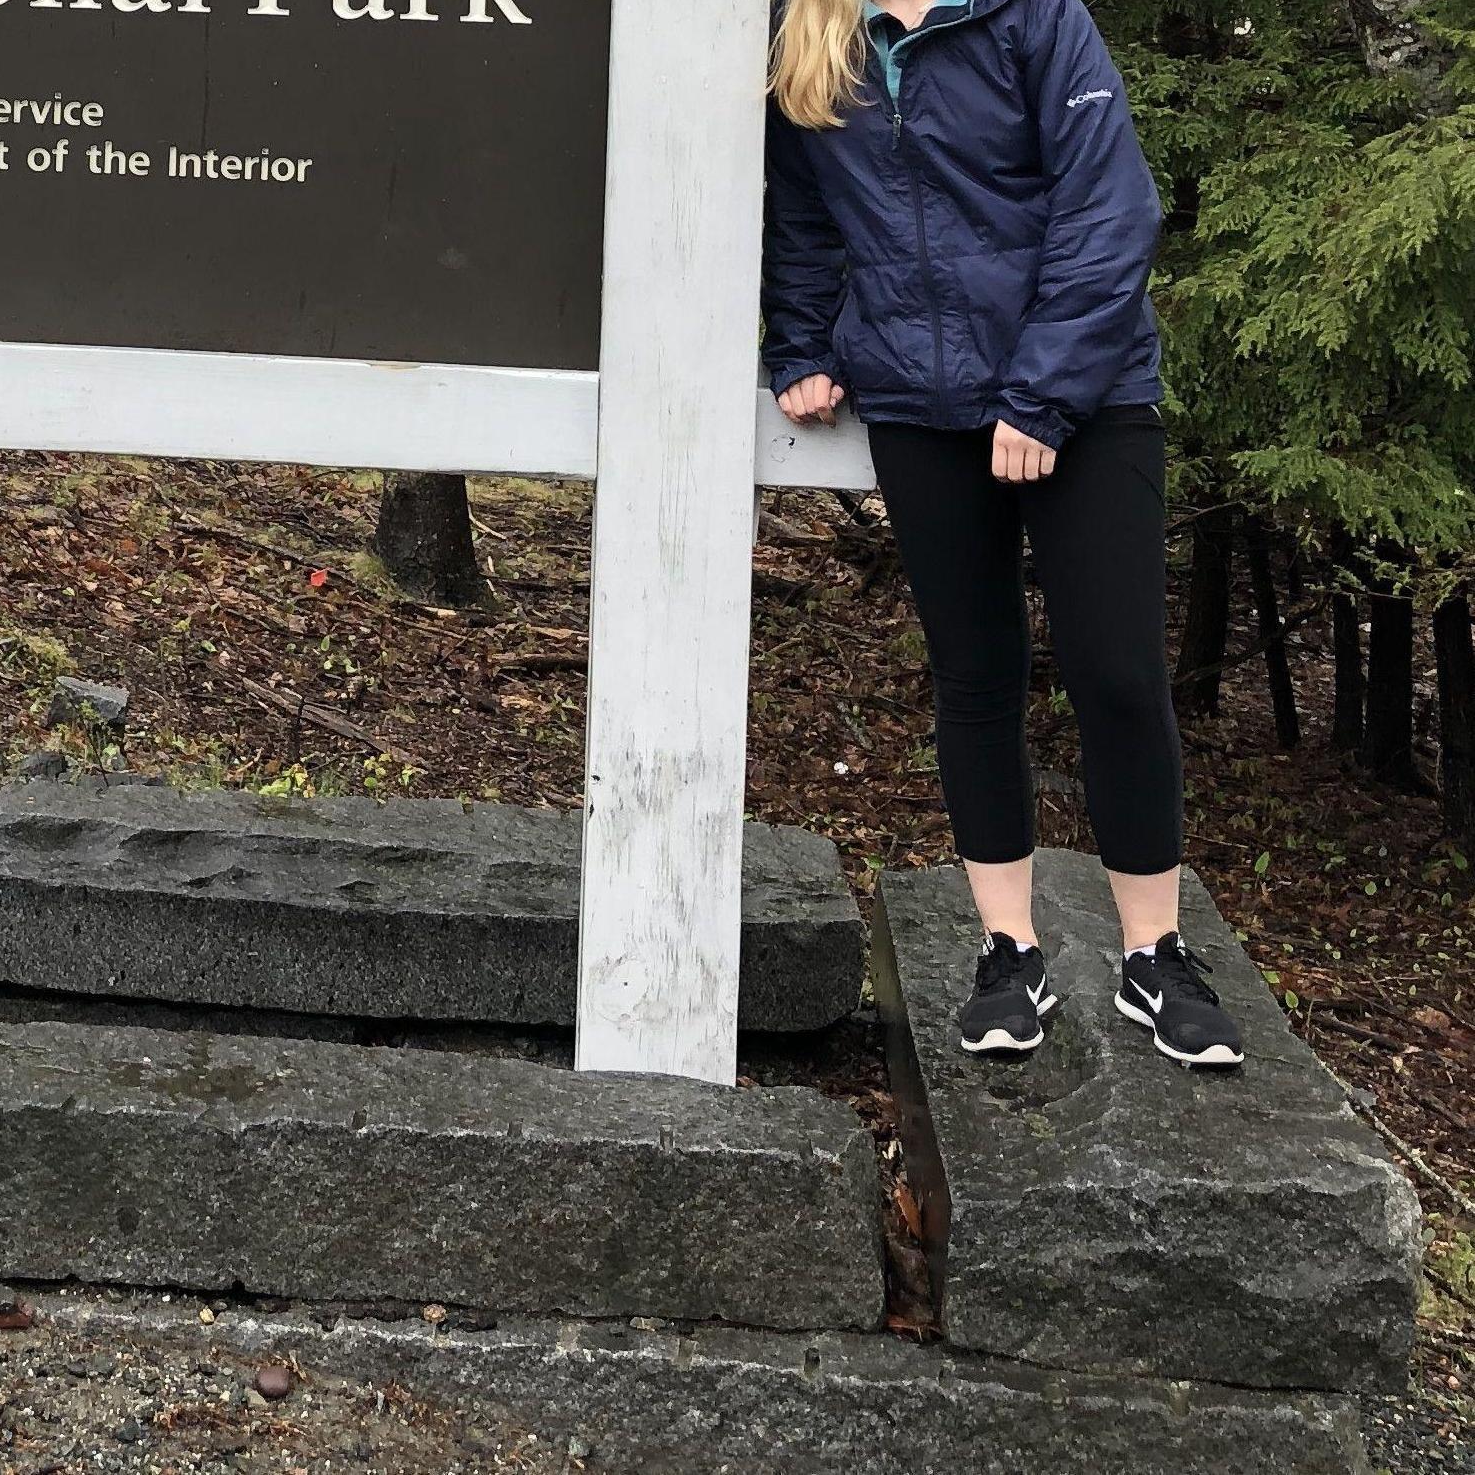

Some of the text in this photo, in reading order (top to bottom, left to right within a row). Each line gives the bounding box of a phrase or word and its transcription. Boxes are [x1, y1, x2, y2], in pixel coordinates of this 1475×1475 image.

[27, 138, 69, 173] of
[85, 140, 151, 176] the
[168, 146, 313, 182] Interior
